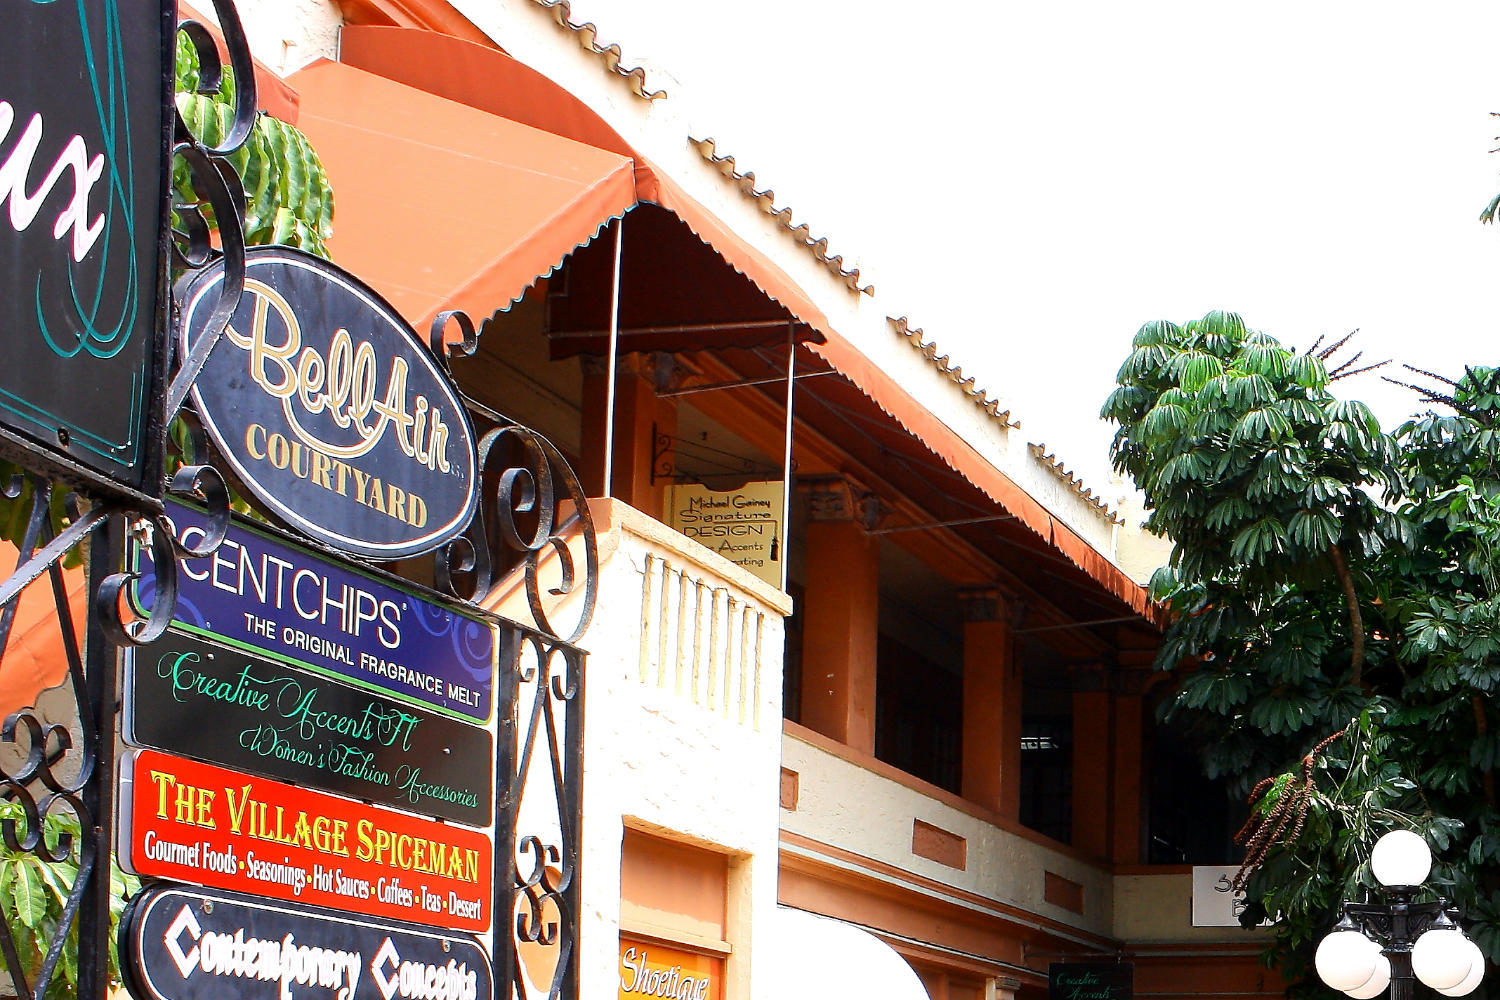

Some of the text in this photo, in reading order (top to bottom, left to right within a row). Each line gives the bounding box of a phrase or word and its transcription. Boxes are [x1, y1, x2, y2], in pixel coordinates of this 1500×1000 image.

[246, 423, 429, 529] COURTYARD
[680, 510, 771, 523] Signature
[689, 495, 771, 514] Michael Gainey
[683, 524, 763, 537] DESIGN
[157, 651, 271, 711] Creative
[277, 680, 382, 740] Accents
[244, 612, 481, 709] THE ORIGINAL FRAGRANCE MELT
[239, 722, 479, 808] Women's Fashion Accessories
[150, 770, 480, 884] THE VILLAGE SPICEMAN
[144, 830, 482, 920] Gourmet Foods Seasonings Hot Sauces Coffees Teas Dessert
